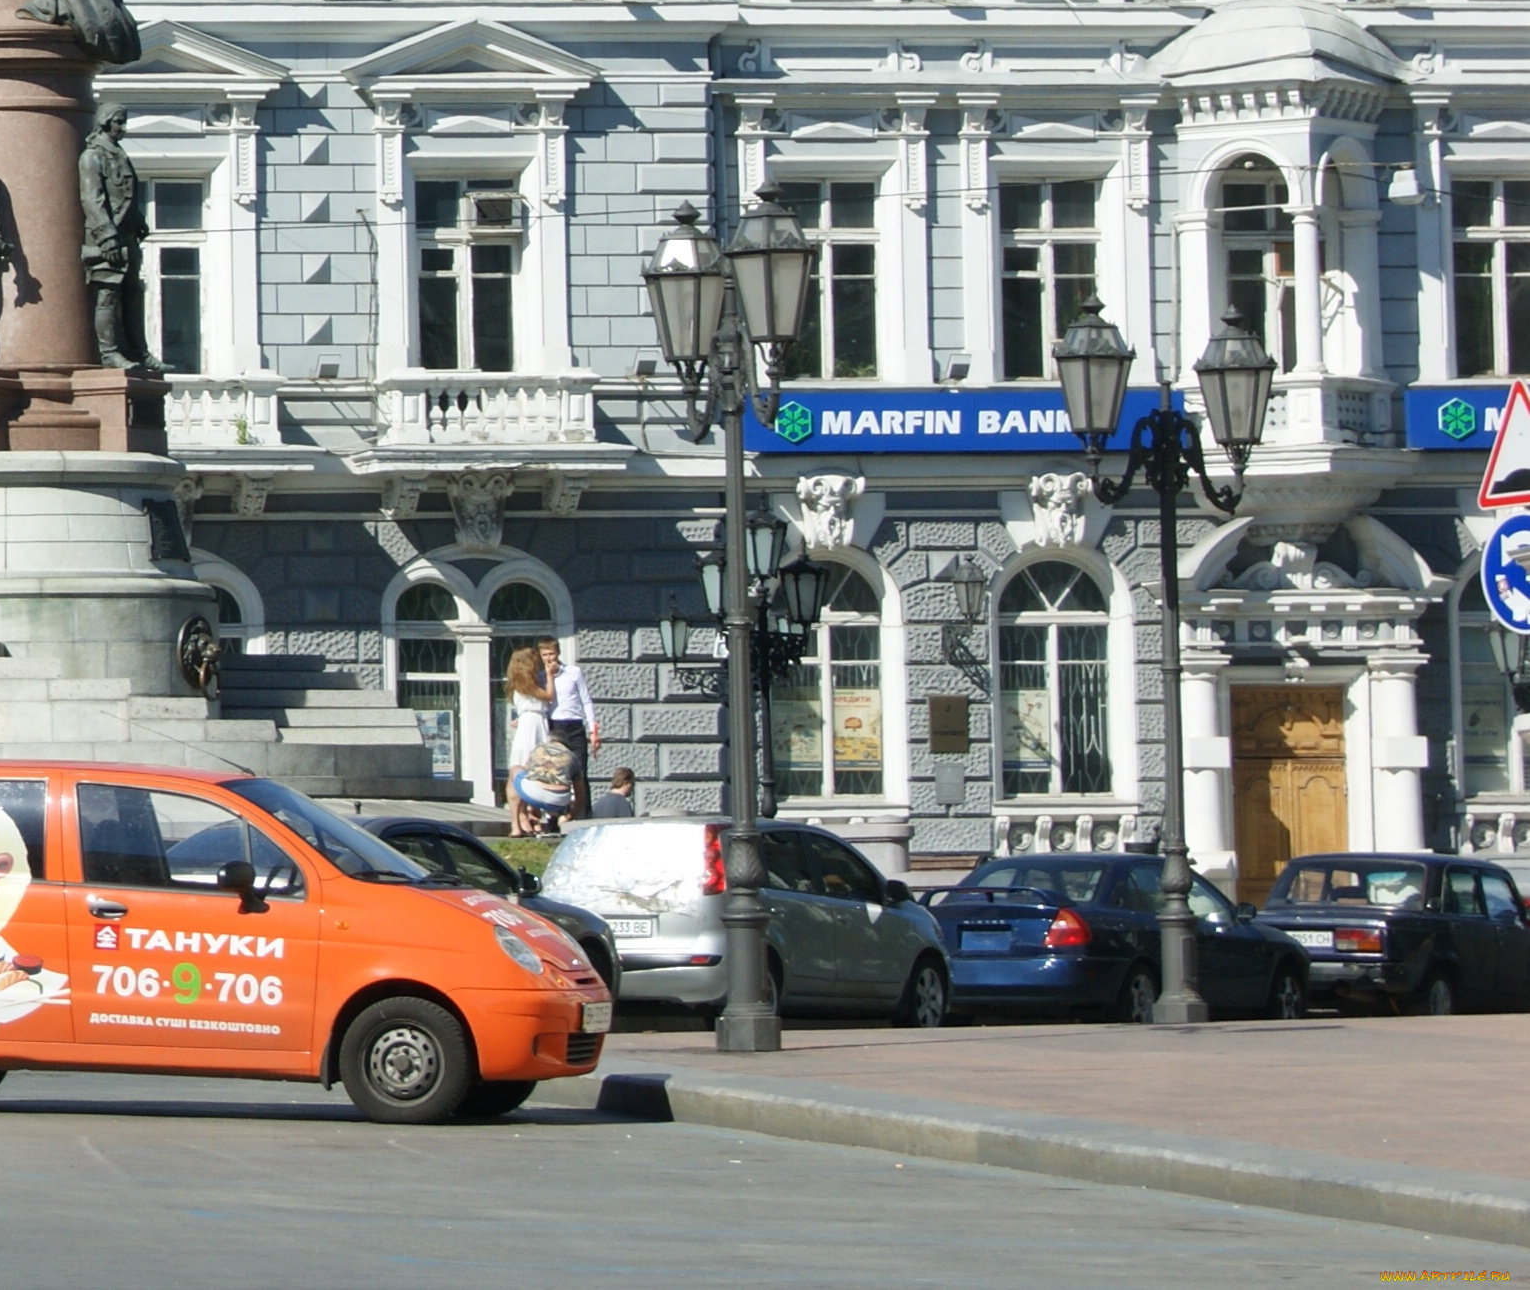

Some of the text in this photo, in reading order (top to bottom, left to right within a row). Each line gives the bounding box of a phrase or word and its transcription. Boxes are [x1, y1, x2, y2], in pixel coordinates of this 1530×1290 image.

[821, 410, 961, 435] MARFIN
[609, 921, 630, 932] 233
[124, 927, 285, 959] ТАНУКИ
[89, 1012, 153, 1027] ДОСТАВКА
[188, 1018, 281, 1035] БЕЗКОШТОВНО
